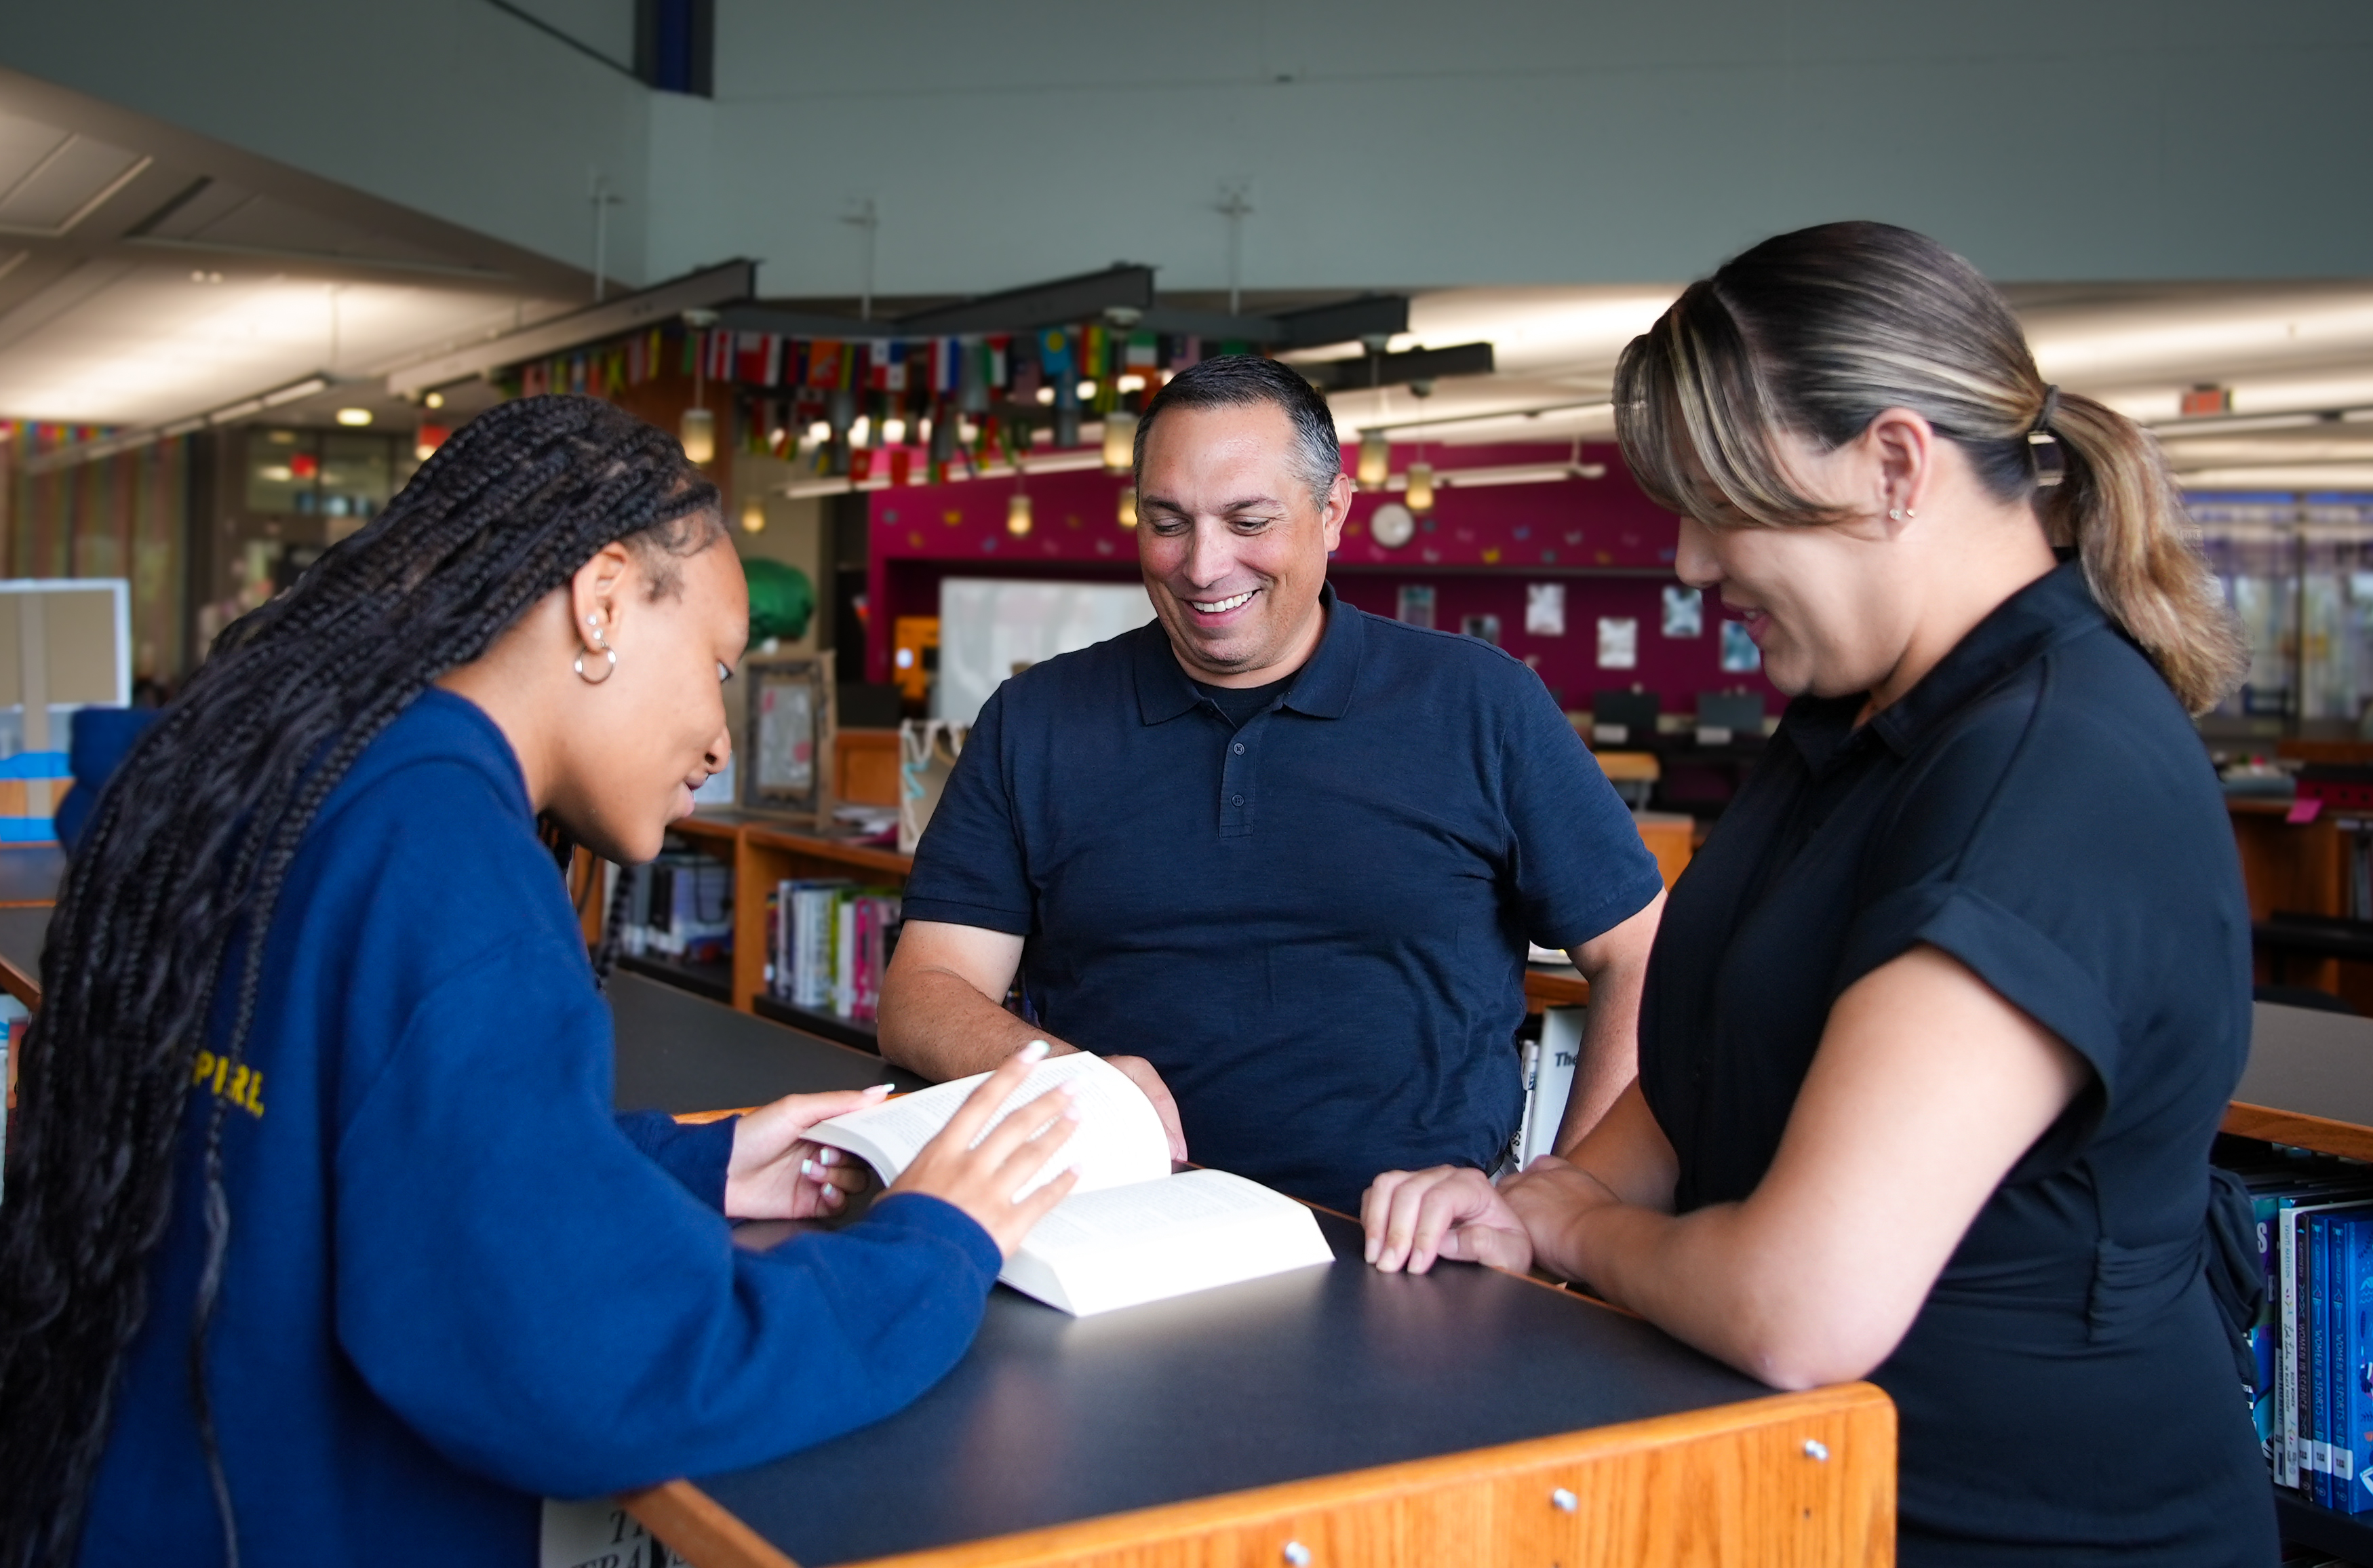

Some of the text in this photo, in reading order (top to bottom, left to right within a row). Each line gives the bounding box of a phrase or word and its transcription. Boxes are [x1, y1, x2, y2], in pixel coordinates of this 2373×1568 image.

[1554, 1052, 1579, 1067] The
[2298, 1323, 2307, 1359] WOMEN
[2299, 1363, 2307, 1372] IN
[2315, 1329, 2324, 1416] WOMEN IN SPORTS
[2336, 1333, 2345, 1421] WOMEN IN SPORTS
